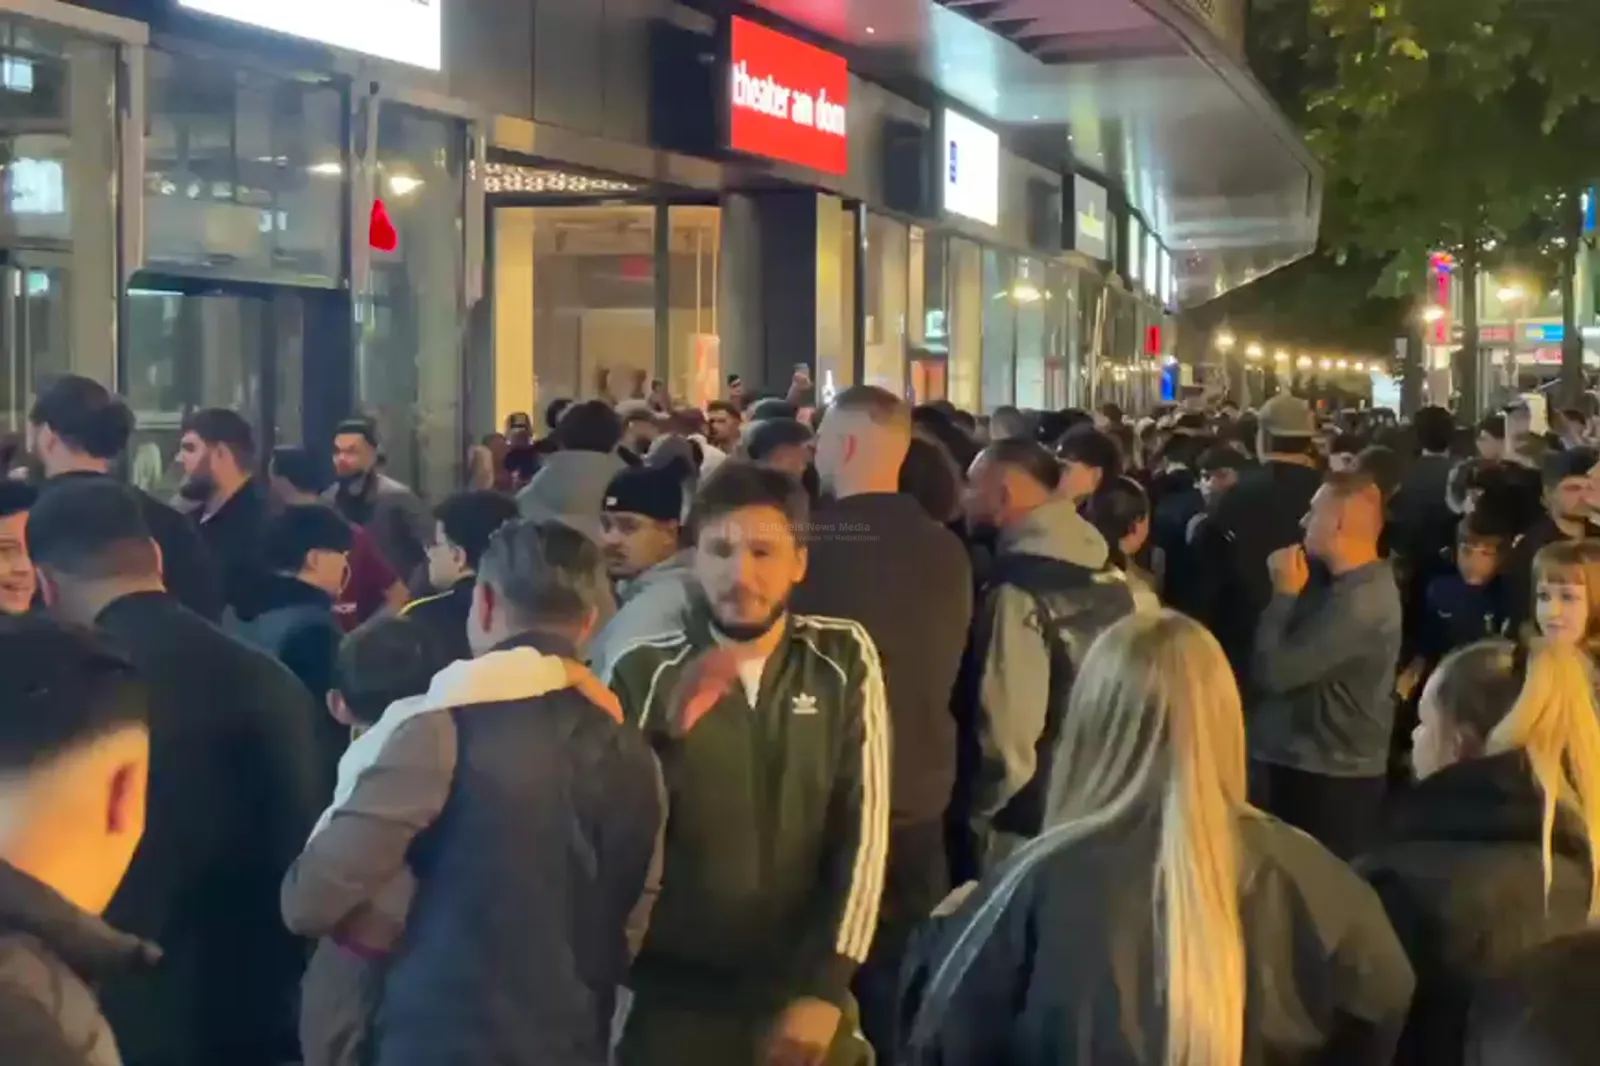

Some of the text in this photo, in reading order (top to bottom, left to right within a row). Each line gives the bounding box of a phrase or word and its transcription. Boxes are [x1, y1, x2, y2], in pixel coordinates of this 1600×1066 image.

[733, 59, 845, 137] theater an dom
